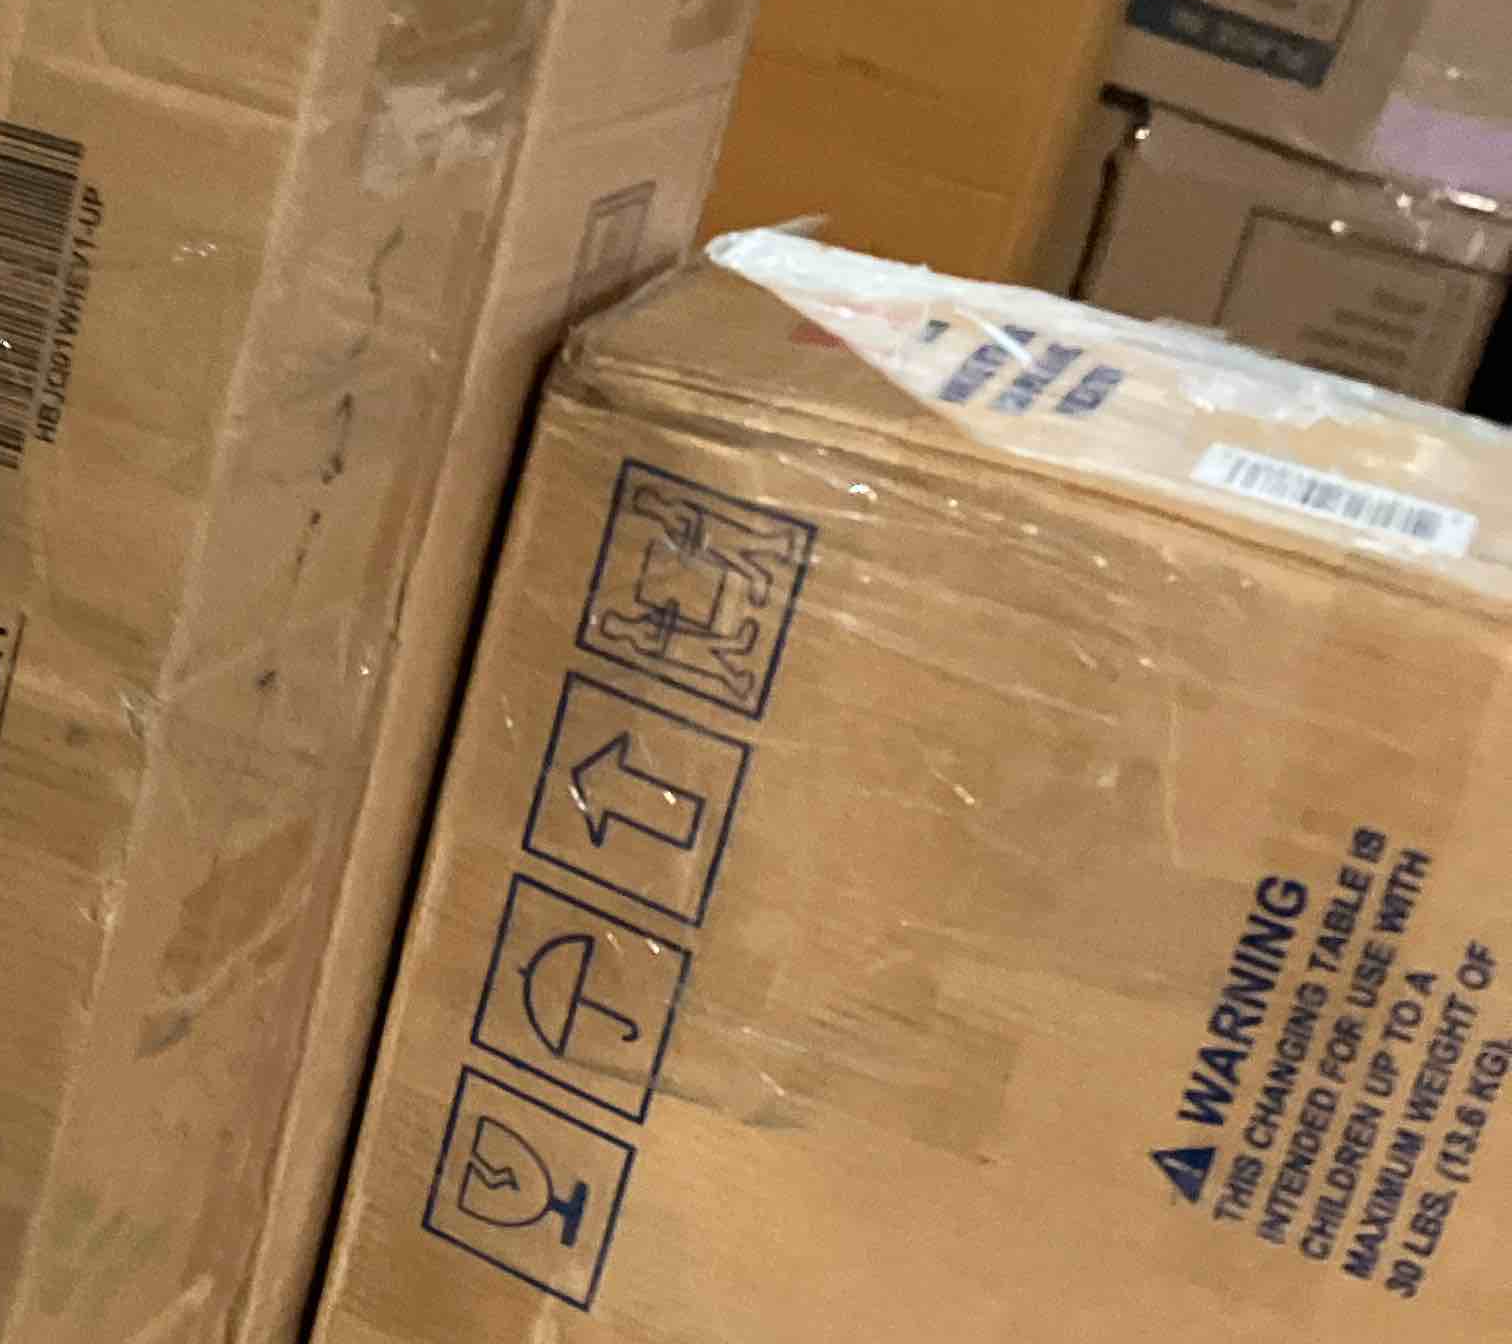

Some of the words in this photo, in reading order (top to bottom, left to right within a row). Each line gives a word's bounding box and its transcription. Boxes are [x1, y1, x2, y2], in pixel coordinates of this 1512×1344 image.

[1178, 874, 1310, 1128] WARNING
[1214, 1153, 1264, 1224] THIS
[1244, 981, 1329, 1150] CHANGING
[1309, 864, 1375, 974] TABLE
[1351, 826, 1388, 865] IS
[1259, 1087, 1339, 1245] INTENDED
[1319, 1016, 1367, 1084] FOR
[1349, 940, 1398, 1009] USE
[1375, 848, 1433, 936] WITH
[1365, 1052, 1404, 1099] UP
[1383, 999, 1423, 1045] TO
[1404, 972, 1438, 1004] A
[1300, 1101, 1383, 1260] CHILDREN
[1342, 1131, 1425, 1282] MAXIMUM
[1410, 993, 1481, 1124] WEIGHT
[1458, 939, 1500, 992] OF
[1386, 1259, 1425, 1299] 30
[1436, 1105, 1488, 1185] (13.6
